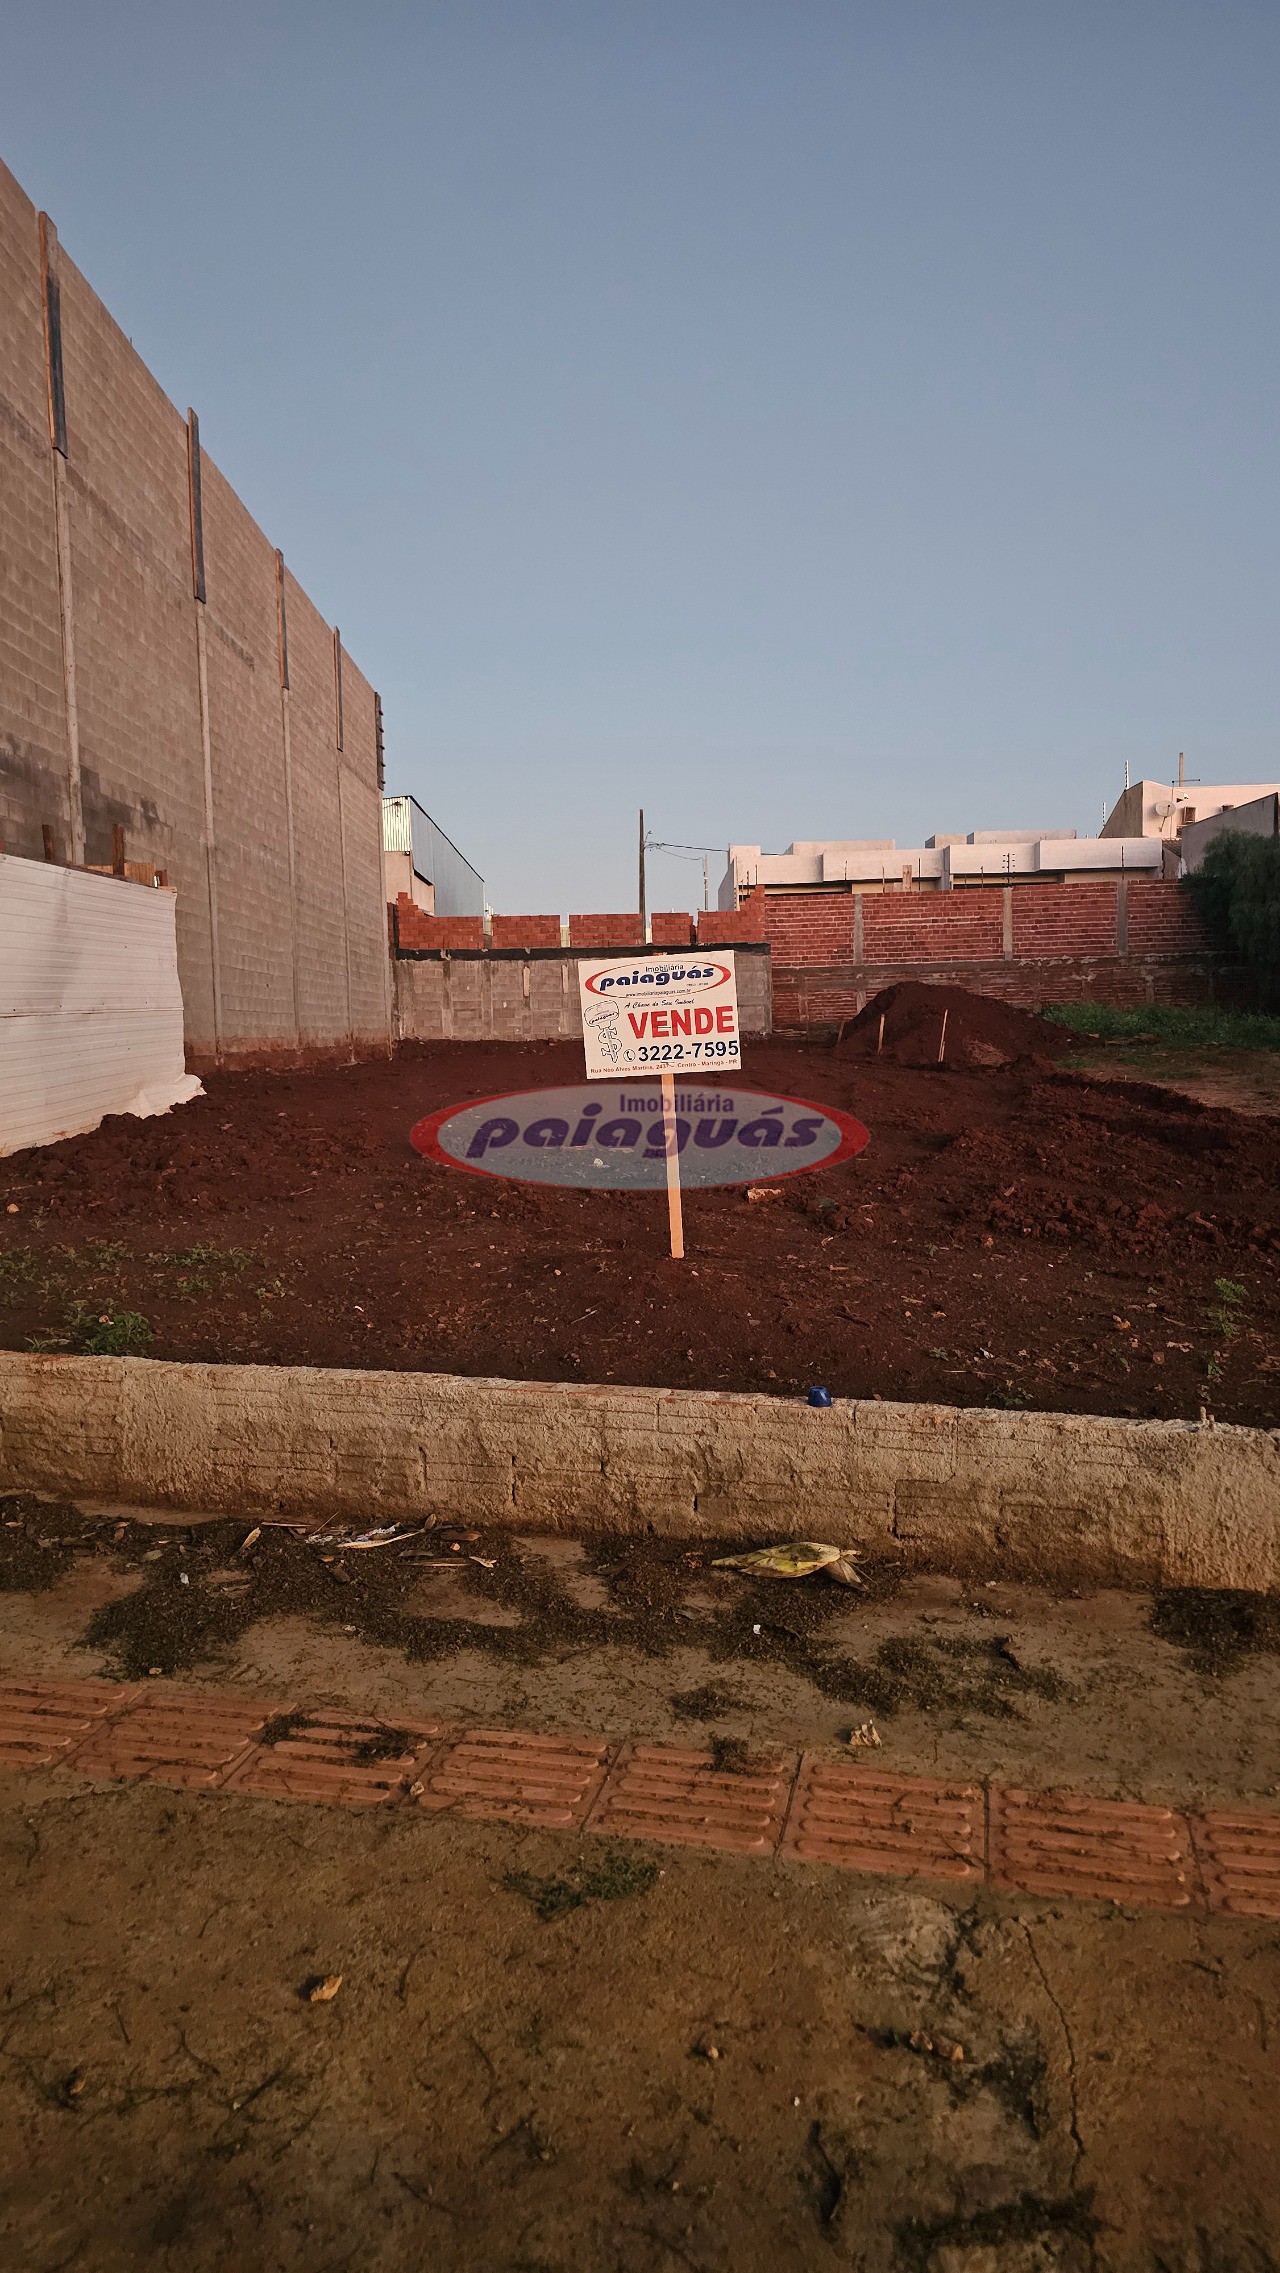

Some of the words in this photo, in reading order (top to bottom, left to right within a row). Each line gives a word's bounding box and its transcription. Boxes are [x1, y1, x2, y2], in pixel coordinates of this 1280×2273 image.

[599, 966, 714, 991] paiaguás
[645, 964, 684, 973] Imobiliária
[627, 1005, 735, 1040] VENDE
[638, 1040, 739, 1062] 3222-7595
